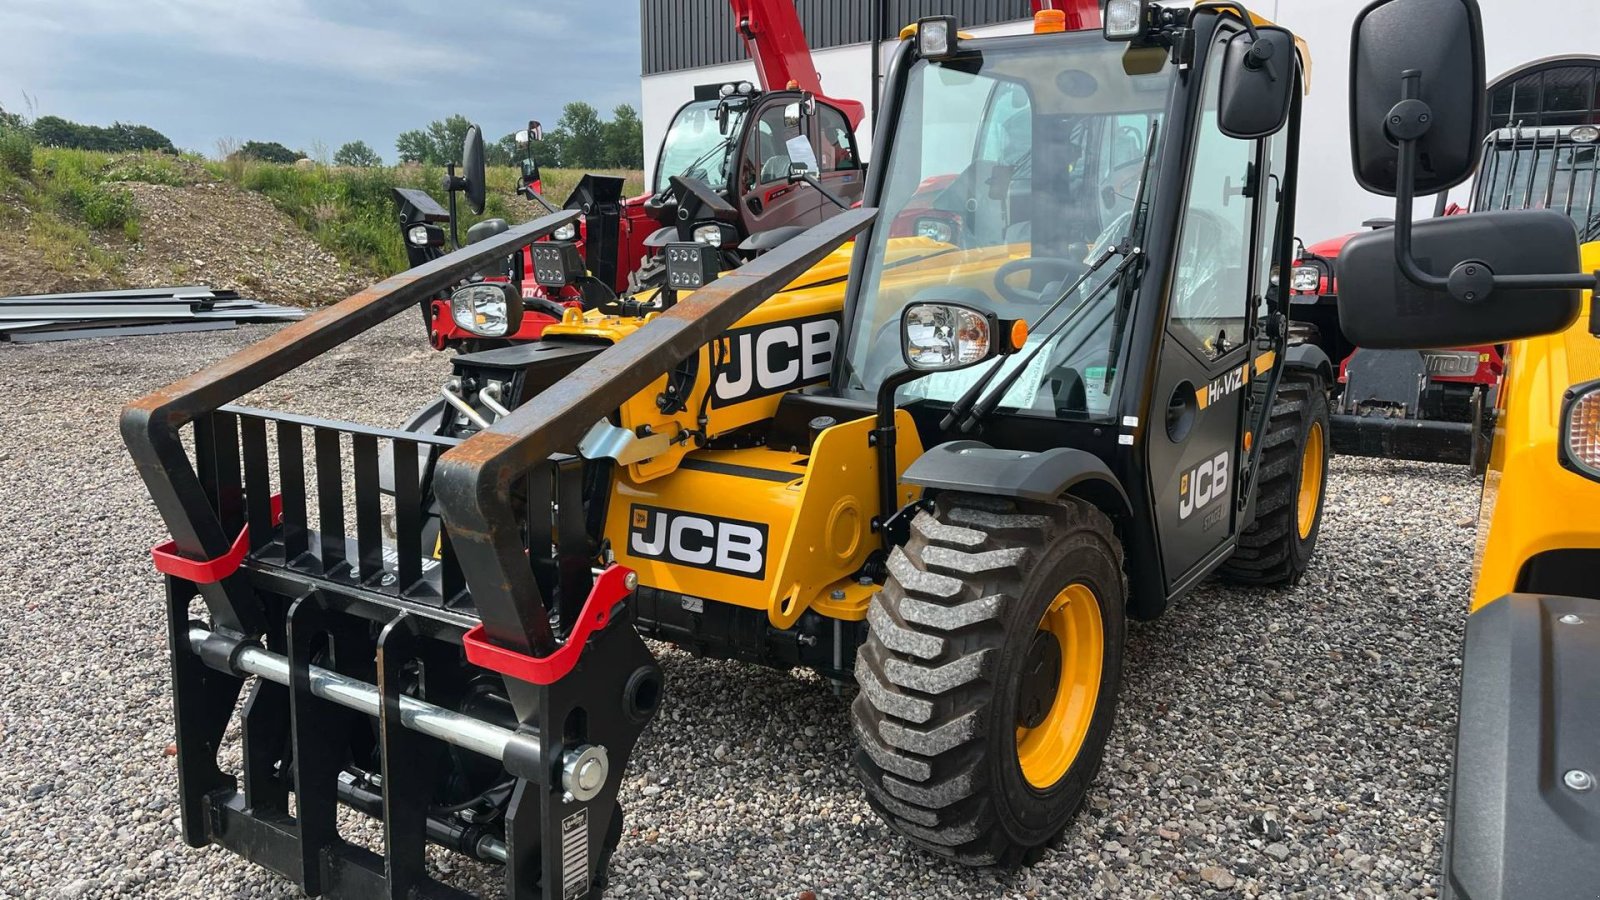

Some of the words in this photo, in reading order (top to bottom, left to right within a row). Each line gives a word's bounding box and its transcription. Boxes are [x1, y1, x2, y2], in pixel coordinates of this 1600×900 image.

[715, 319, 839, 400] JCB
[1180, 450, 1228, 520] JCB
[631, 511, 763, 573] JCB
